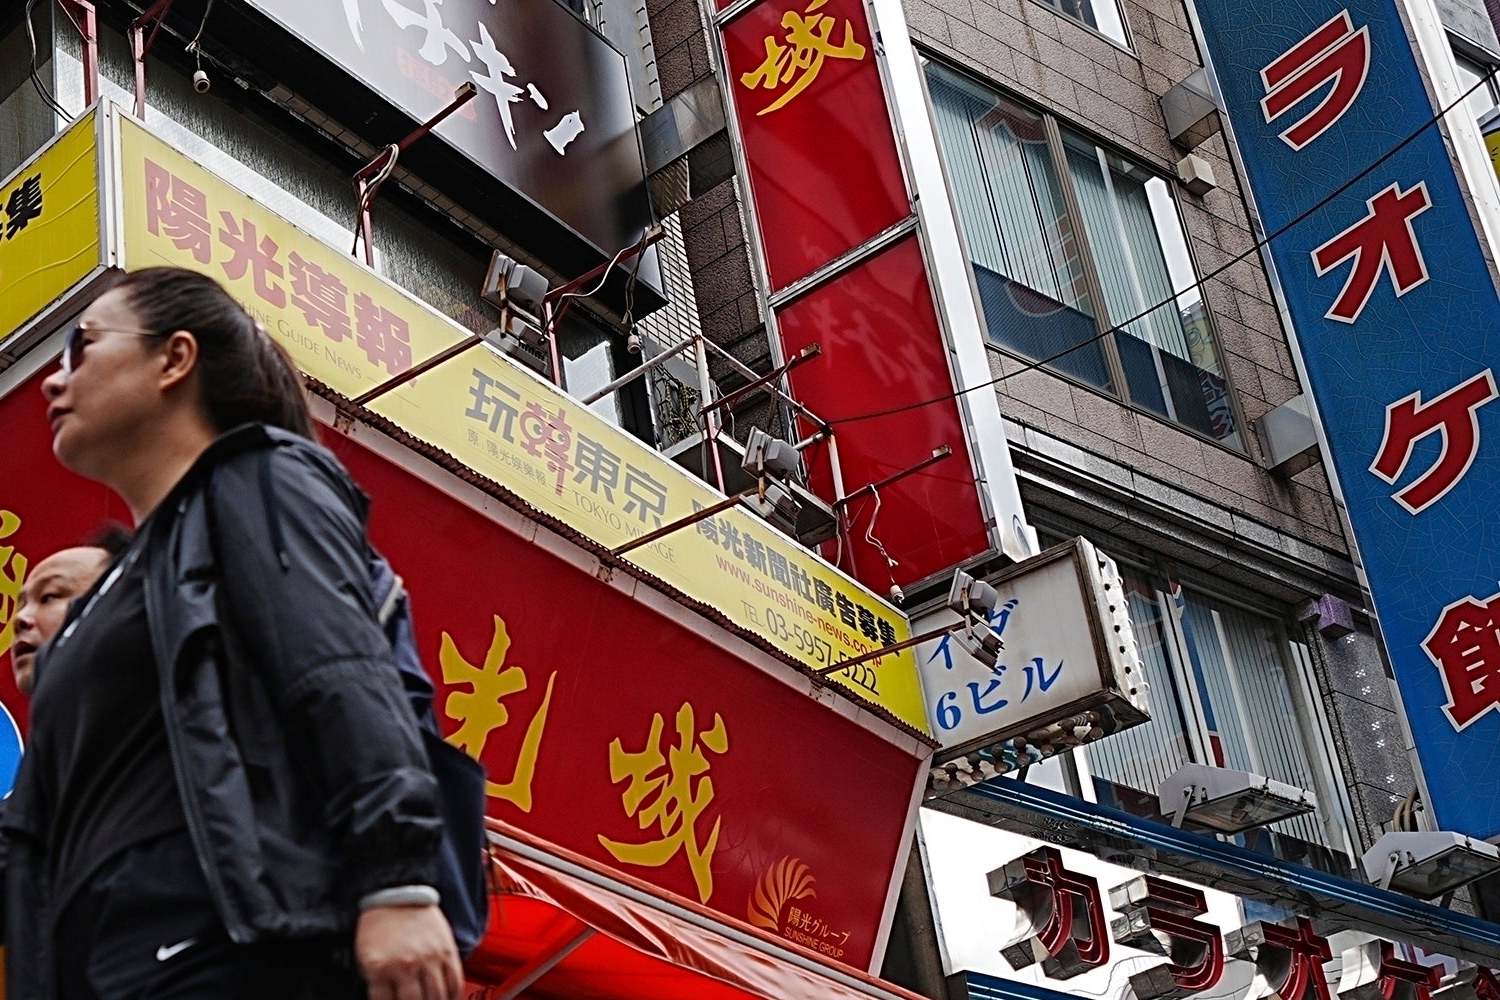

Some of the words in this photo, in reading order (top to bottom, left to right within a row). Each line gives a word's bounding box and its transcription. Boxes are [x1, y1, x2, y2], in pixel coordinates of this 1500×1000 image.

[144, 156, 418, 388] 陽光導報
[572, 490, 622, 530] TOKYO
[691, 498, 900, 657] 陽光新聞社廣告募集
[766, 607, 879, 696] 03-5957-5222
[936, 657, 1064, 730] 6ビル
[784, 926, 819, 950] SUNSHINE
[819, 941, 844, 959] GROUP
[787, 906, 851, 946] 陽光グループ
